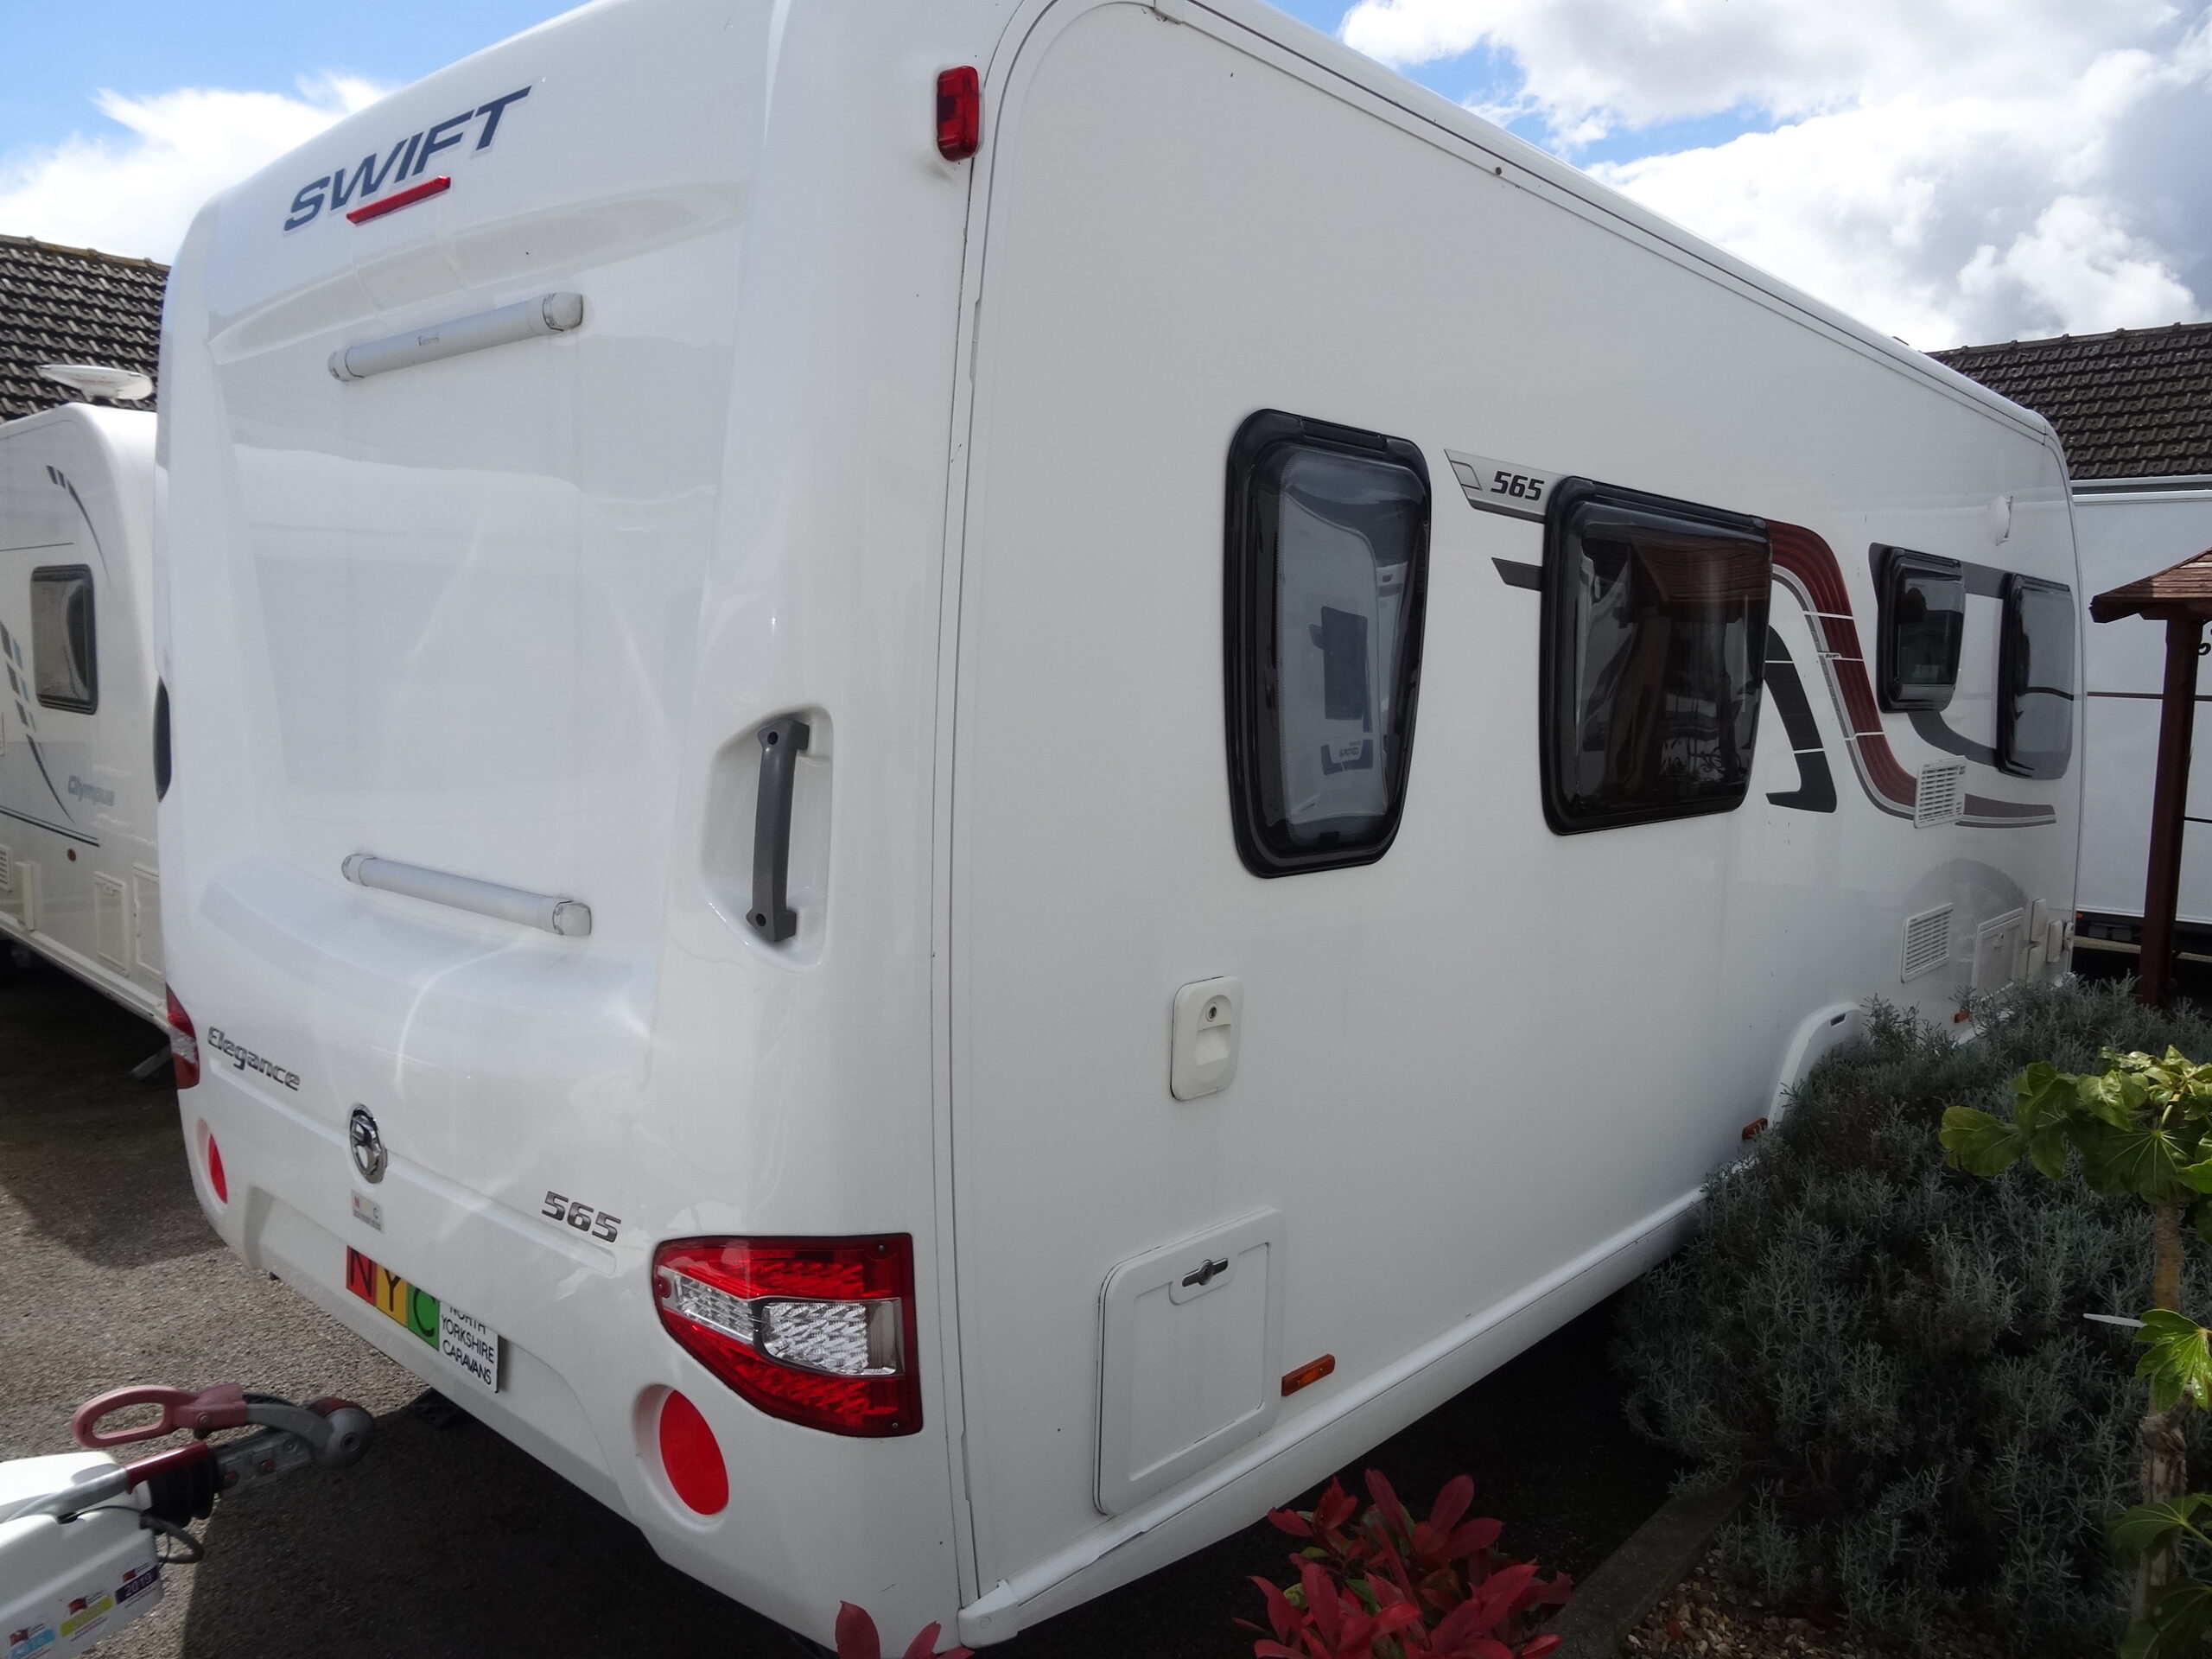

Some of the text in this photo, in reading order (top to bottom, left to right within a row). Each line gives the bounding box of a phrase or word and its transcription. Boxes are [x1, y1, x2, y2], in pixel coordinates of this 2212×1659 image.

[283, 85, 532, 232] SWIFT
[1491, 470, 1545, 501] 565
[207, 1026, 301, 1091] Elegance
[541, 1190, 622, 1243] 565
[441, 1313, 494, 1364] YORKSHIRE
[442, 1339, 492, 1386] CARAVANS
[124, 1573, 153, 1598] 2019
